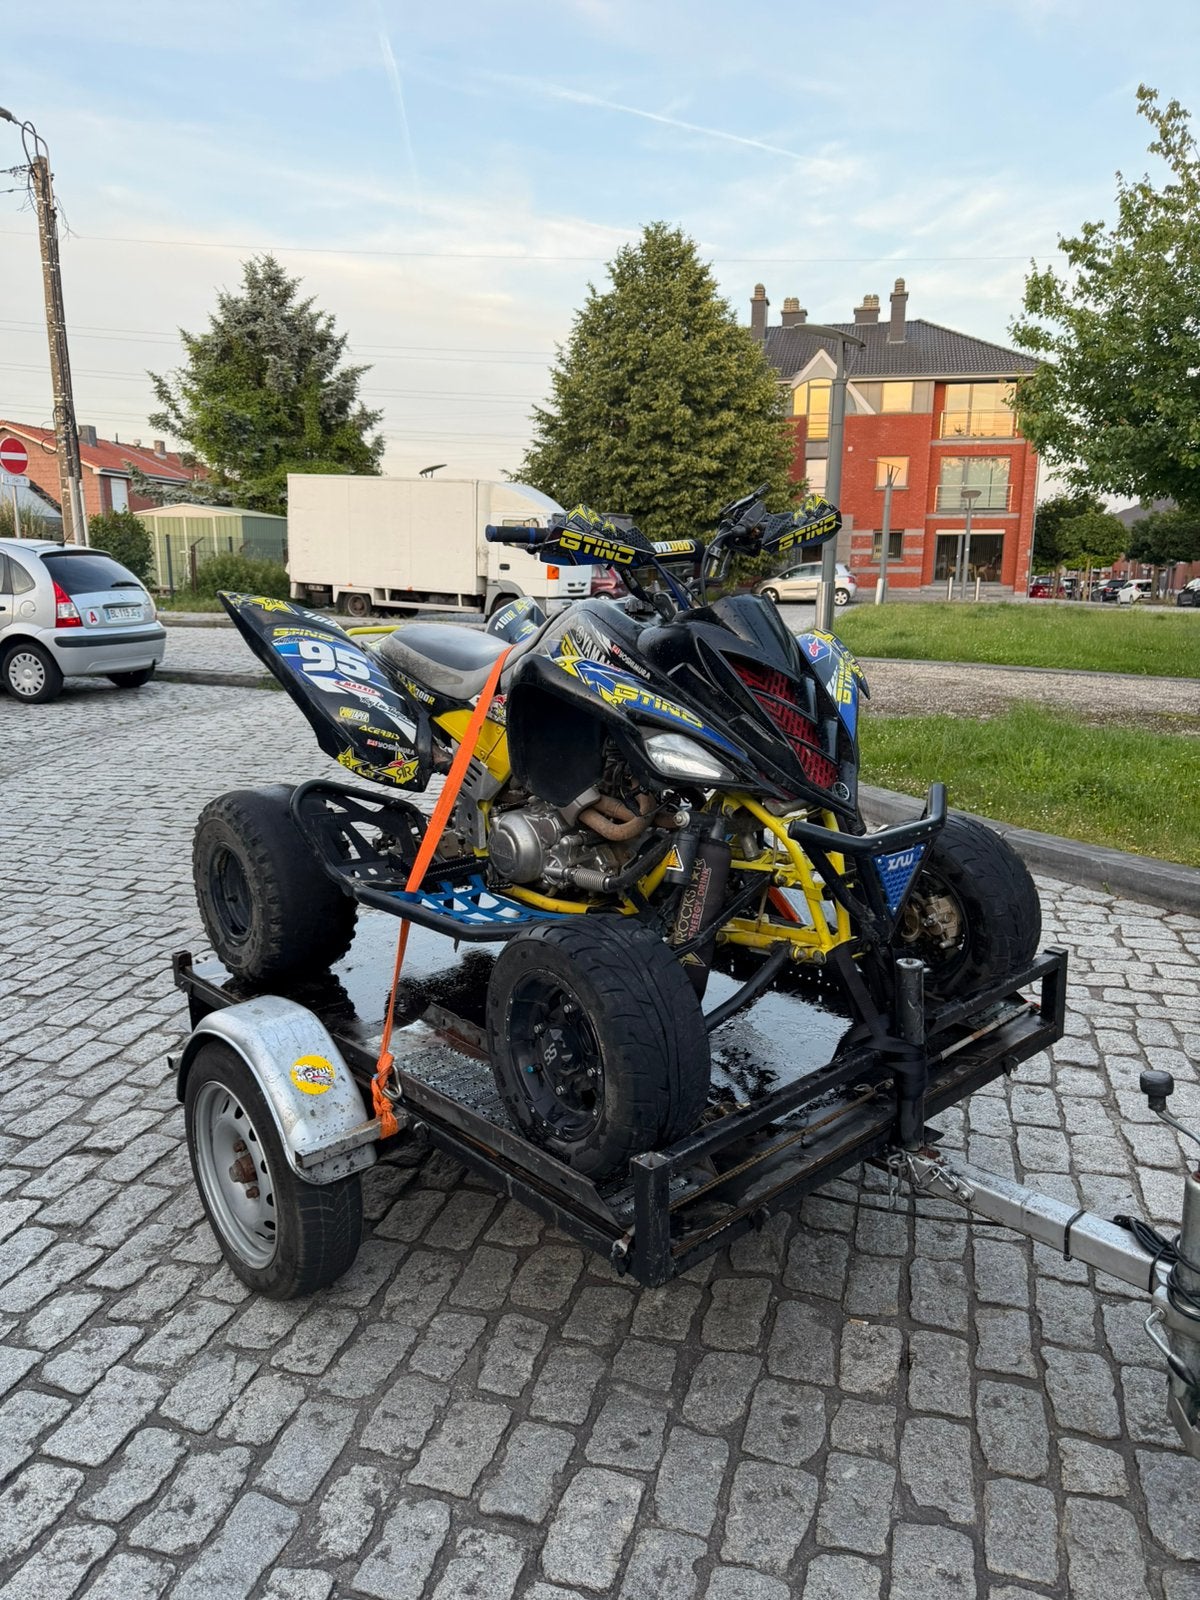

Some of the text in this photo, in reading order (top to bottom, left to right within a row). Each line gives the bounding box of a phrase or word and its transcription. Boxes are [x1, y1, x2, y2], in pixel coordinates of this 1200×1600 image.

[89, 611, 98, 623] A
[299, 640, 371, 681] 95
[583, 633, 613, 667] YAMA
[343, 681, 377, 695] MAXXIS
[698, 867, 709, 896] DRINK
[296, 1066, 332, 1082] MOTUL
